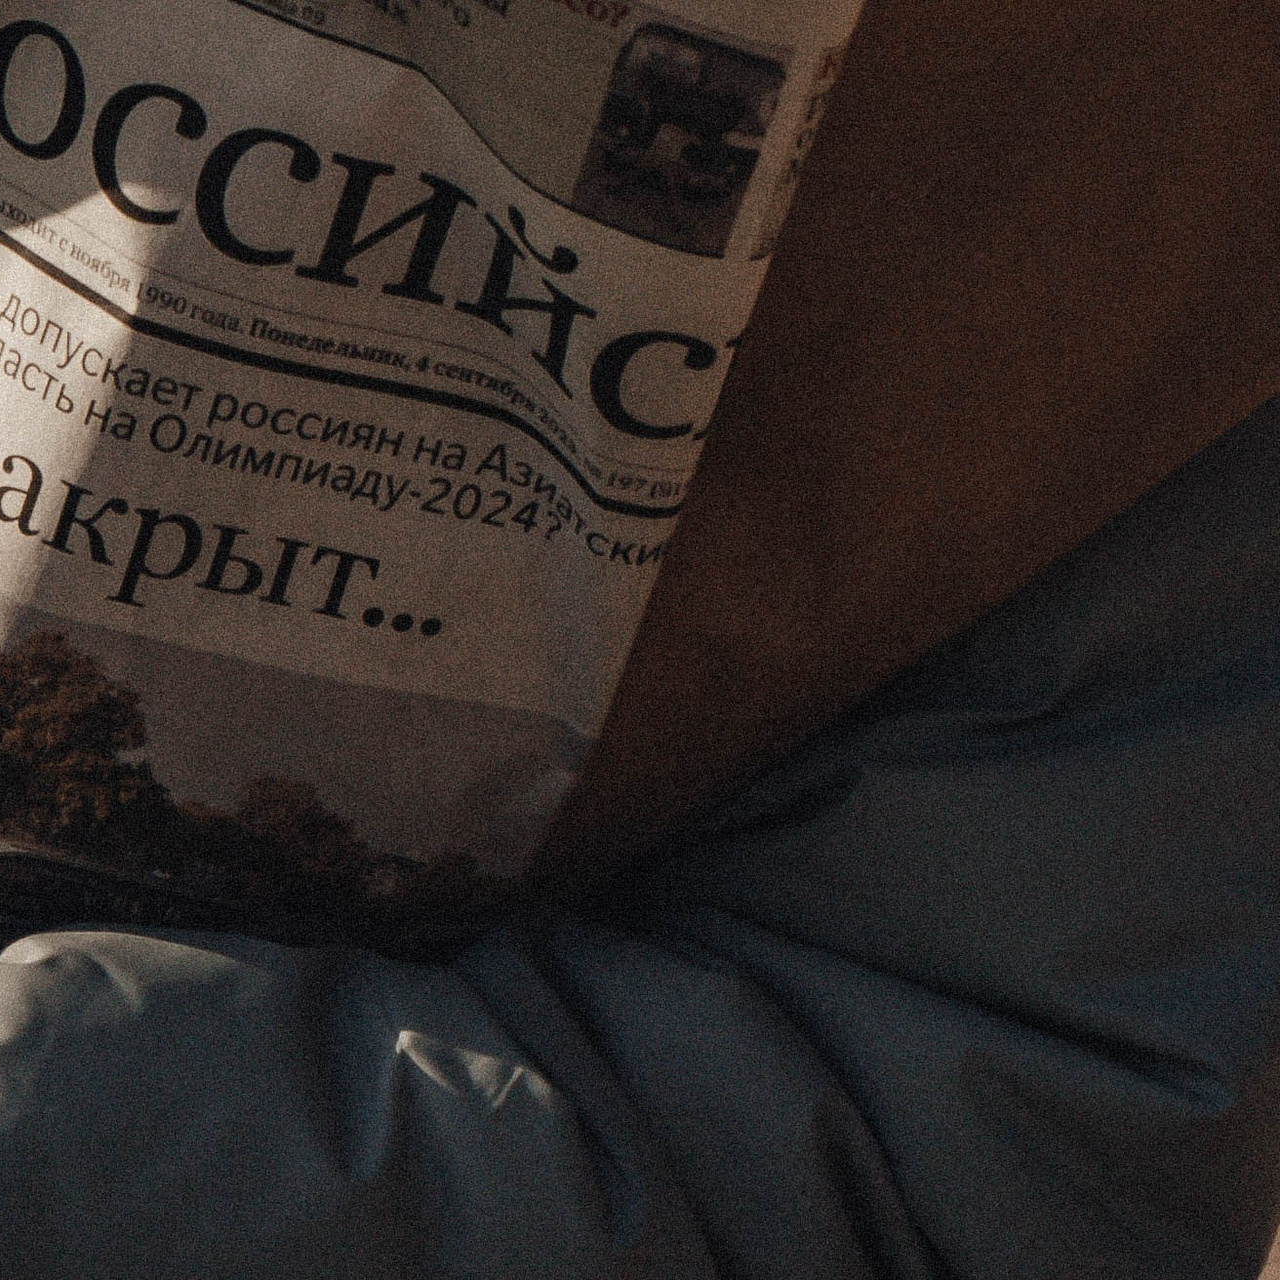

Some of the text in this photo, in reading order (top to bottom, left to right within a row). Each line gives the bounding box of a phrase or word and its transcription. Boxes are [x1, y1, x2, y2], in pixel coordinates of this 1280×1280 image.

[69, 241, 131, 295] ноября
[138, 282, 189, 316] 1990
[249, 317, 412, 372] Понедельник,
[83, 401, 139, 441] на
[149, 413, 563, 540] Олимпиаду-2024?
[209, 387, 405, 458] россиян
[412, 434, 468, 472] на
